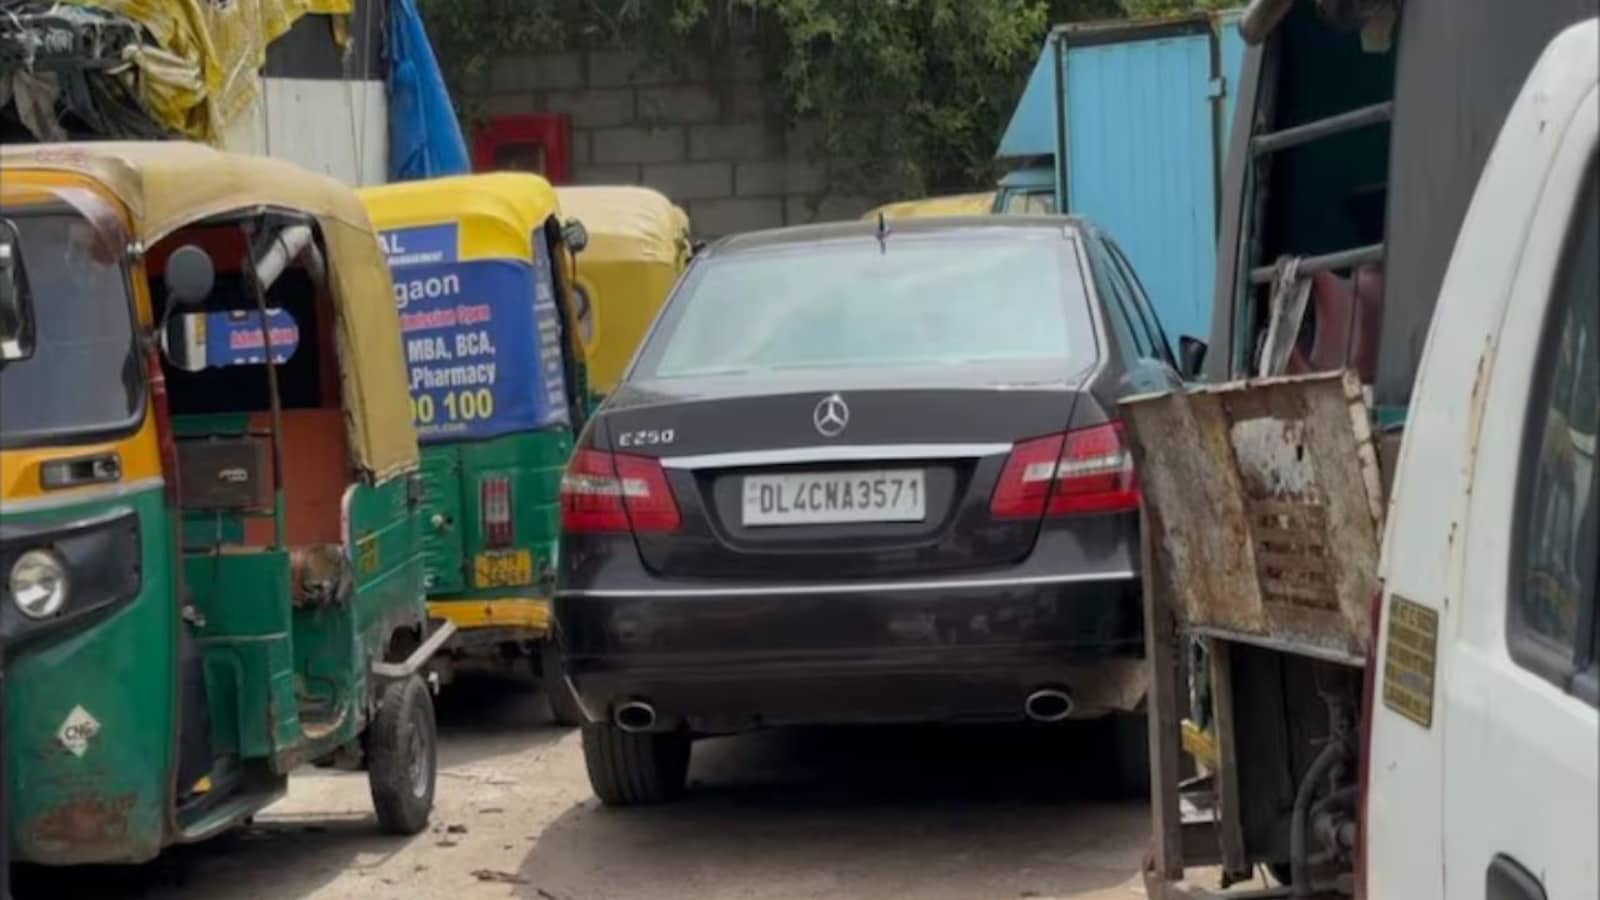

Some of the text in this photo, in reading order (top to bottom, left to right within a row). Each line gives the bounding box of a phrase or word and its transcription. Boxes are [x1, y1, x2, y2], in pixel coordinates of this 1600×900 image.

[394, 274, 459, 309] gaon
[408, 331, 496, 363] MBA, BCA,
[443, 388, 493, 420] 100
[619, 429, 675, 447] E250
[760, 479, 920, 514] DL4CNA3571
